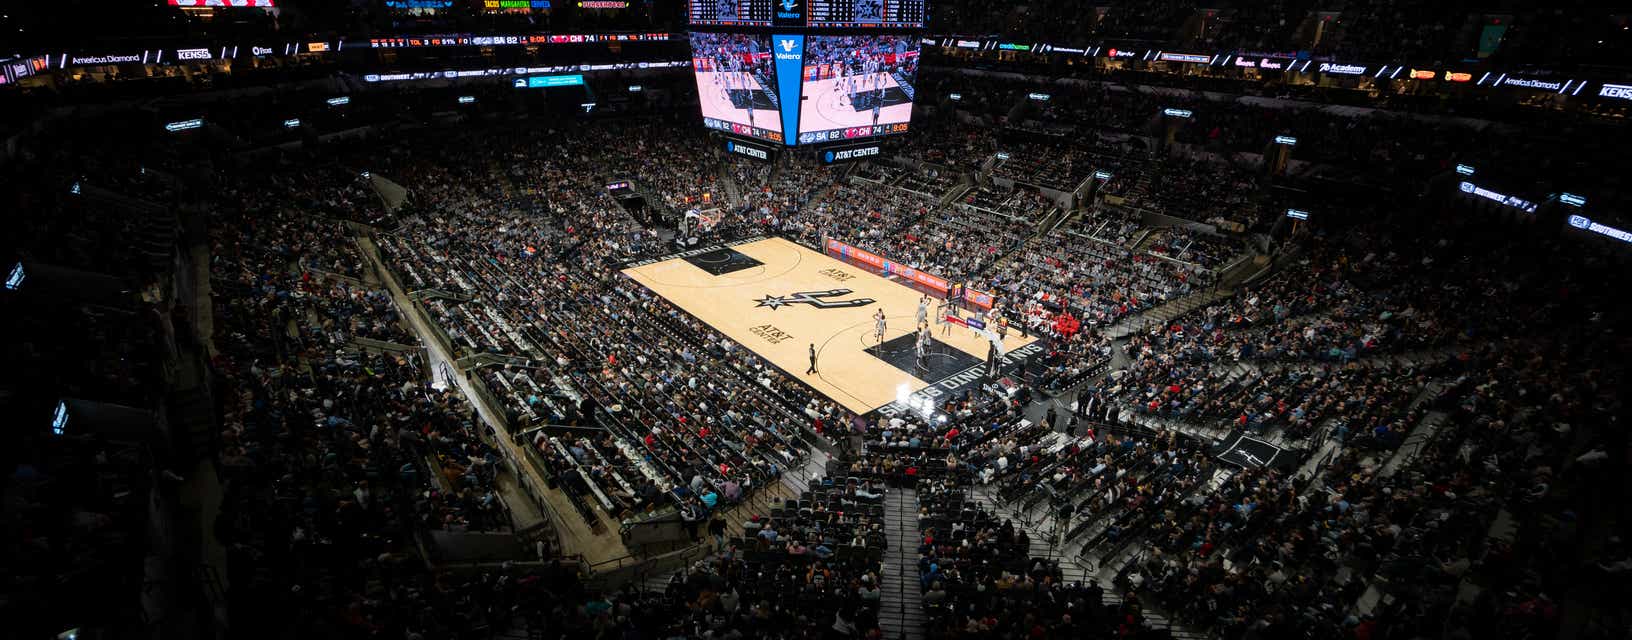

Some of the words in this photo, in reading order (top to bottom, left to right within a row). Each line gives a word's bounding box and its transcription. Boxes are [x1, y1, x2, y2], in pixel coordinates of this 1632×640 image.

[507, 36, 518, 45] 82
[584, 34, 595, 42] 74
[107, 54, 140, 63] Diamond
[1330, 63, 1367, 74] Academy
[1530, 79, 1561, 90] Diamond
[816, 131, 827, 140] SA
[829, 130, 840, 140] 82
[859, 126, 871, 136] CHI
[872, 125, 882, 134] 74
[893, 123, 907, 132] 9:05
[746, 147, 767, 160] CENTER
[835, 150, 853, 161] AT&T
[852, 147, 879, 158] CENTER
[757, 323, 795, 342] AT&T
